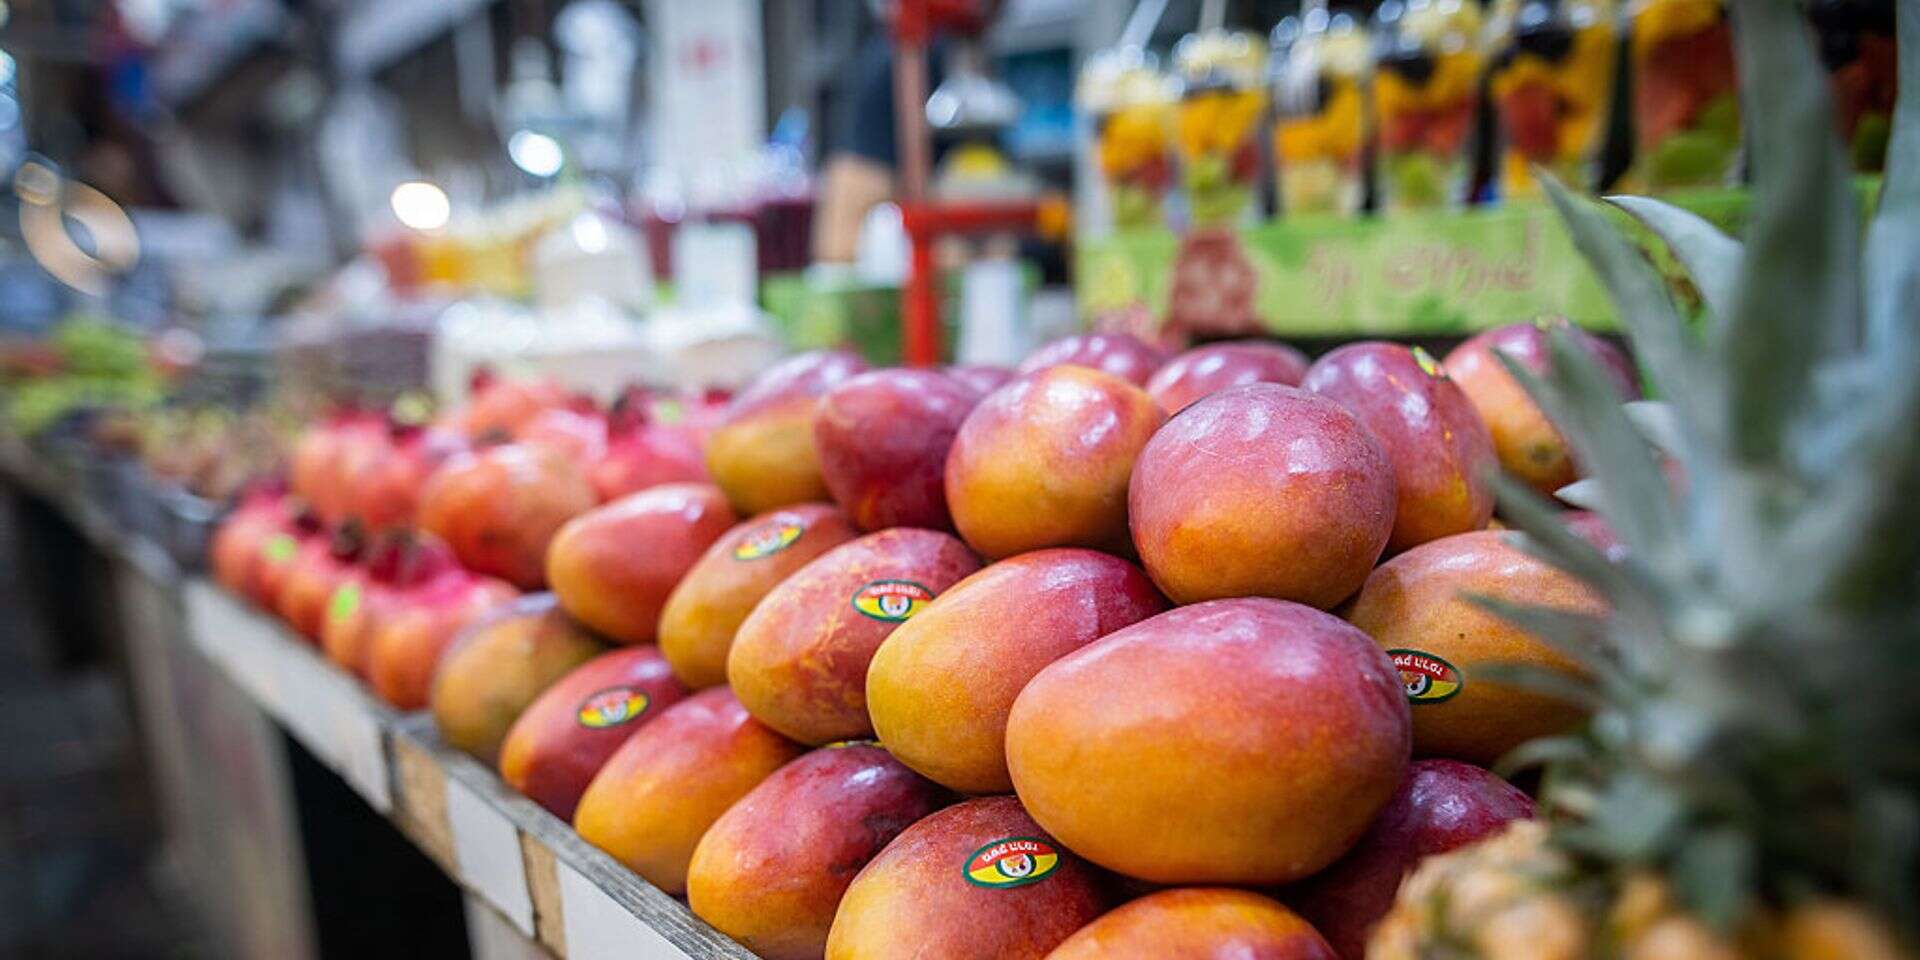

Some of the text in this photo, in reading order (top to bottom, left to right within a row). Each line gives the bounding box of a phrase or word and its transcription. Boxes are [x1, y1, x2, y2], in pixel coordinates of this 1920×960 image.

[1394, 654, 1444, 676] שק הרפז
[981, 841, 1039, 863] משק הרפז
